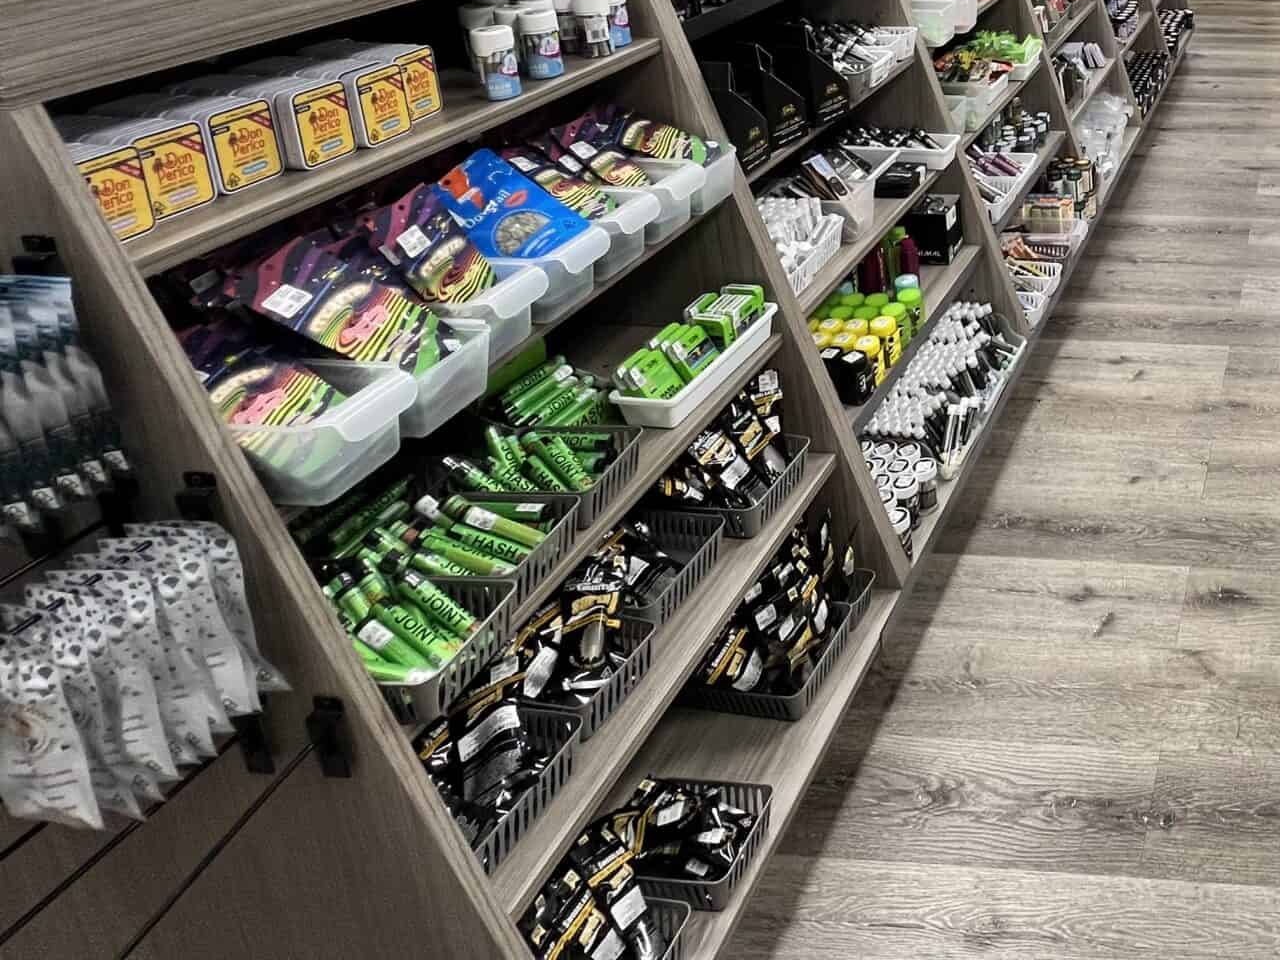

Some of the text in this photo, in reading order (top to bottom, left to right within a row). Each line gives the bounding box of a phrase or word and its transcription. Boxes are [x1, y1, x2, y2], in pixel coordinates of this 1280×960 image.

[316, 105, 340, 123] Don
[236, 126, 263, 143] Don
[312, 118, 342, 135] Perico
[230, 139, 266, 157] Perico
[165, 151, 193, 170] Don
[157, 166, 196, 186] Perico
[101, 178, 131, 196] Don
[101, 189, 134, 210] erico
[550, 448, 581, 479] JOINT
[470, 534, 519, 560] HASH
[420, 593, 468, 629] JOINT
[393, 614, 440, 646] JOINT
